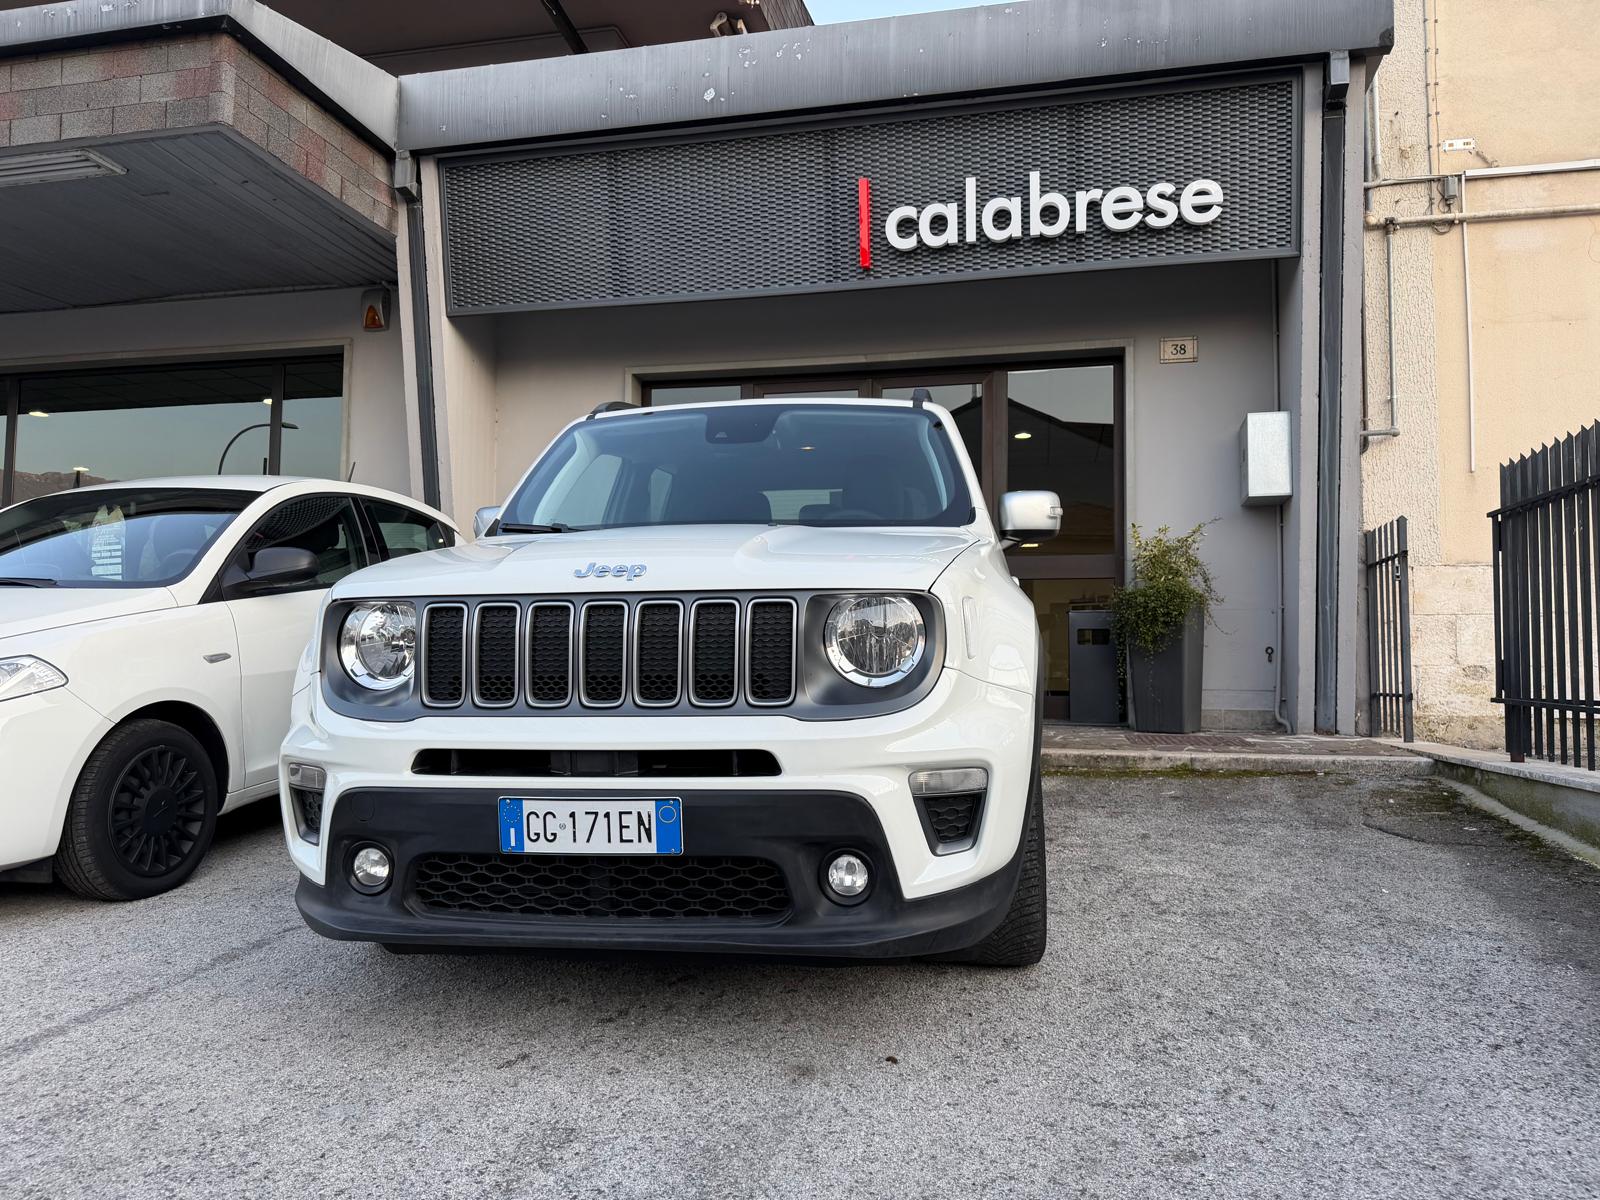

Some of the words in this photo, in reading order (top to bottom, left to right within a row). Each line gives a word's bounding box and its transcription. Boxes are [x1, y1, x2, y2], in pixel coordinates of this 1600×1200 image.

[885, 171, 1224, 252] calabrese
[1170, 343, 1187, 356] 38
[574, 562, 647, 581] Jeep
